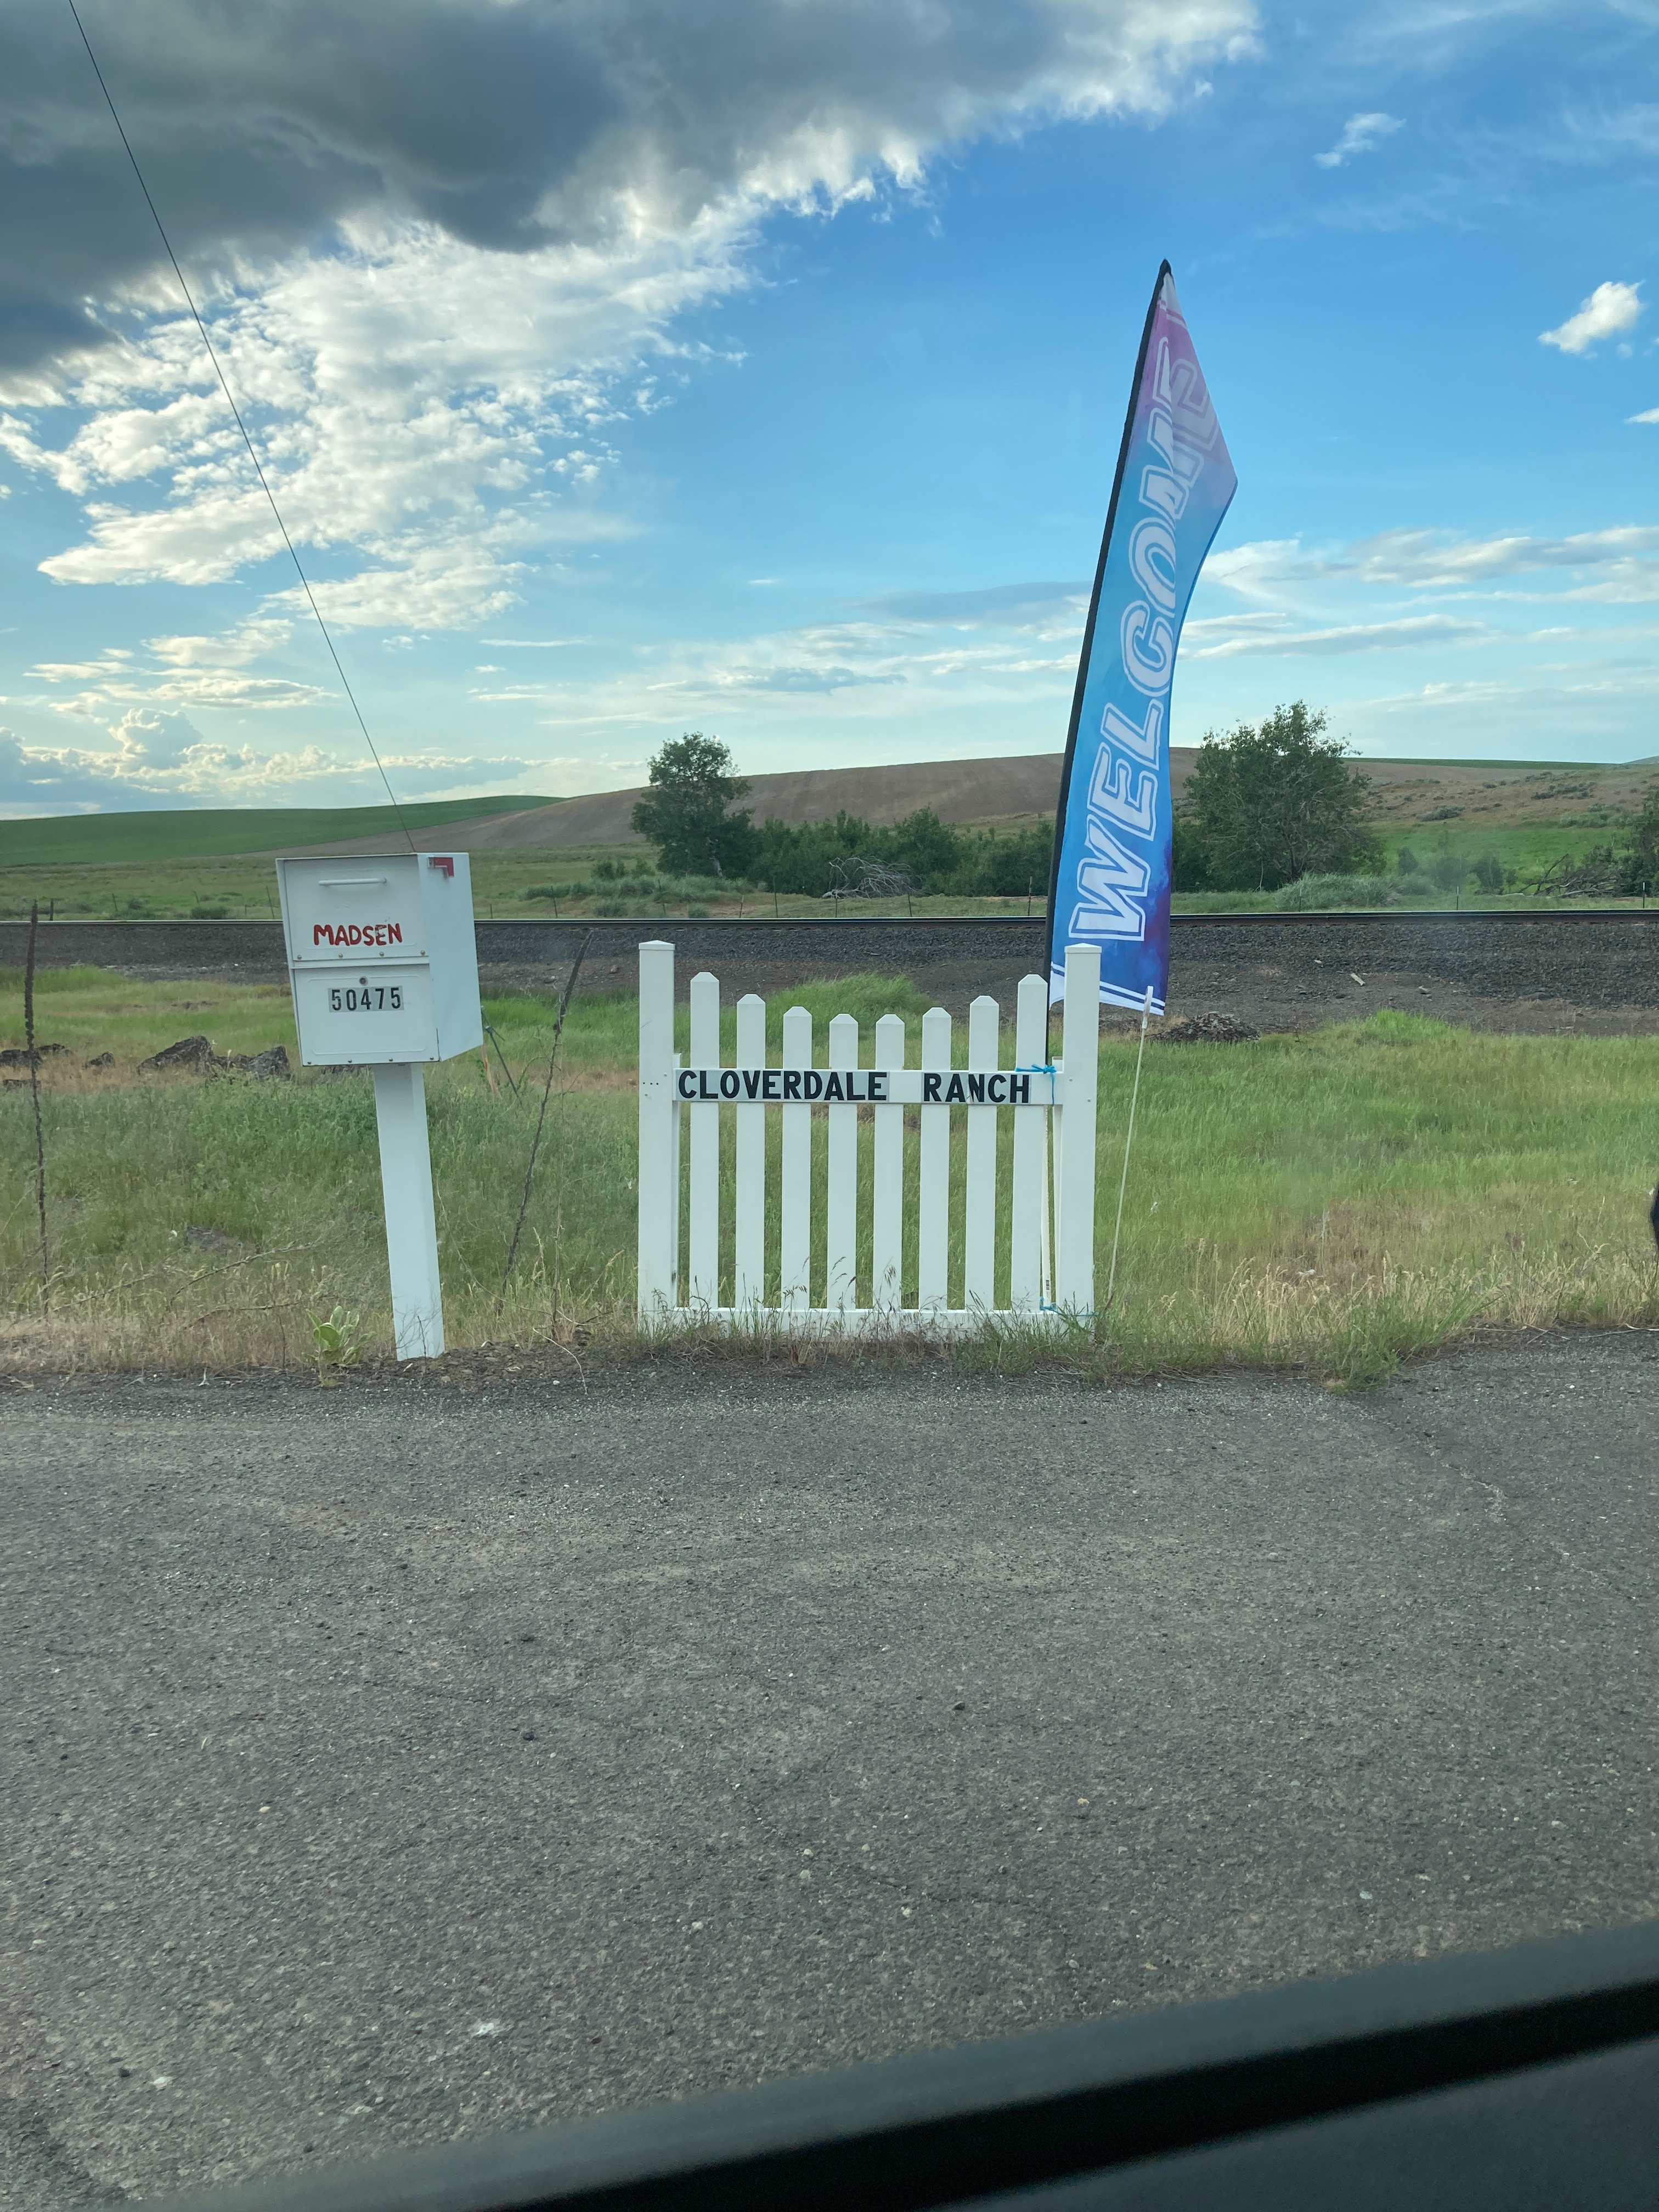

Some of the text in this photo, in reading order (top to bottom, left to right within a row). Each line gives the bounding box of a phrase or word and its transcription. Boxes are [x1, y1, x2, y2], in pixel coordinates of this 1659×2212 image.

[313, 923, 403, 946] MADSEN
[331, 988, 401, 1011] 50475
[678, 1070, 1029, 1103] CLOVERDALE RANCH
